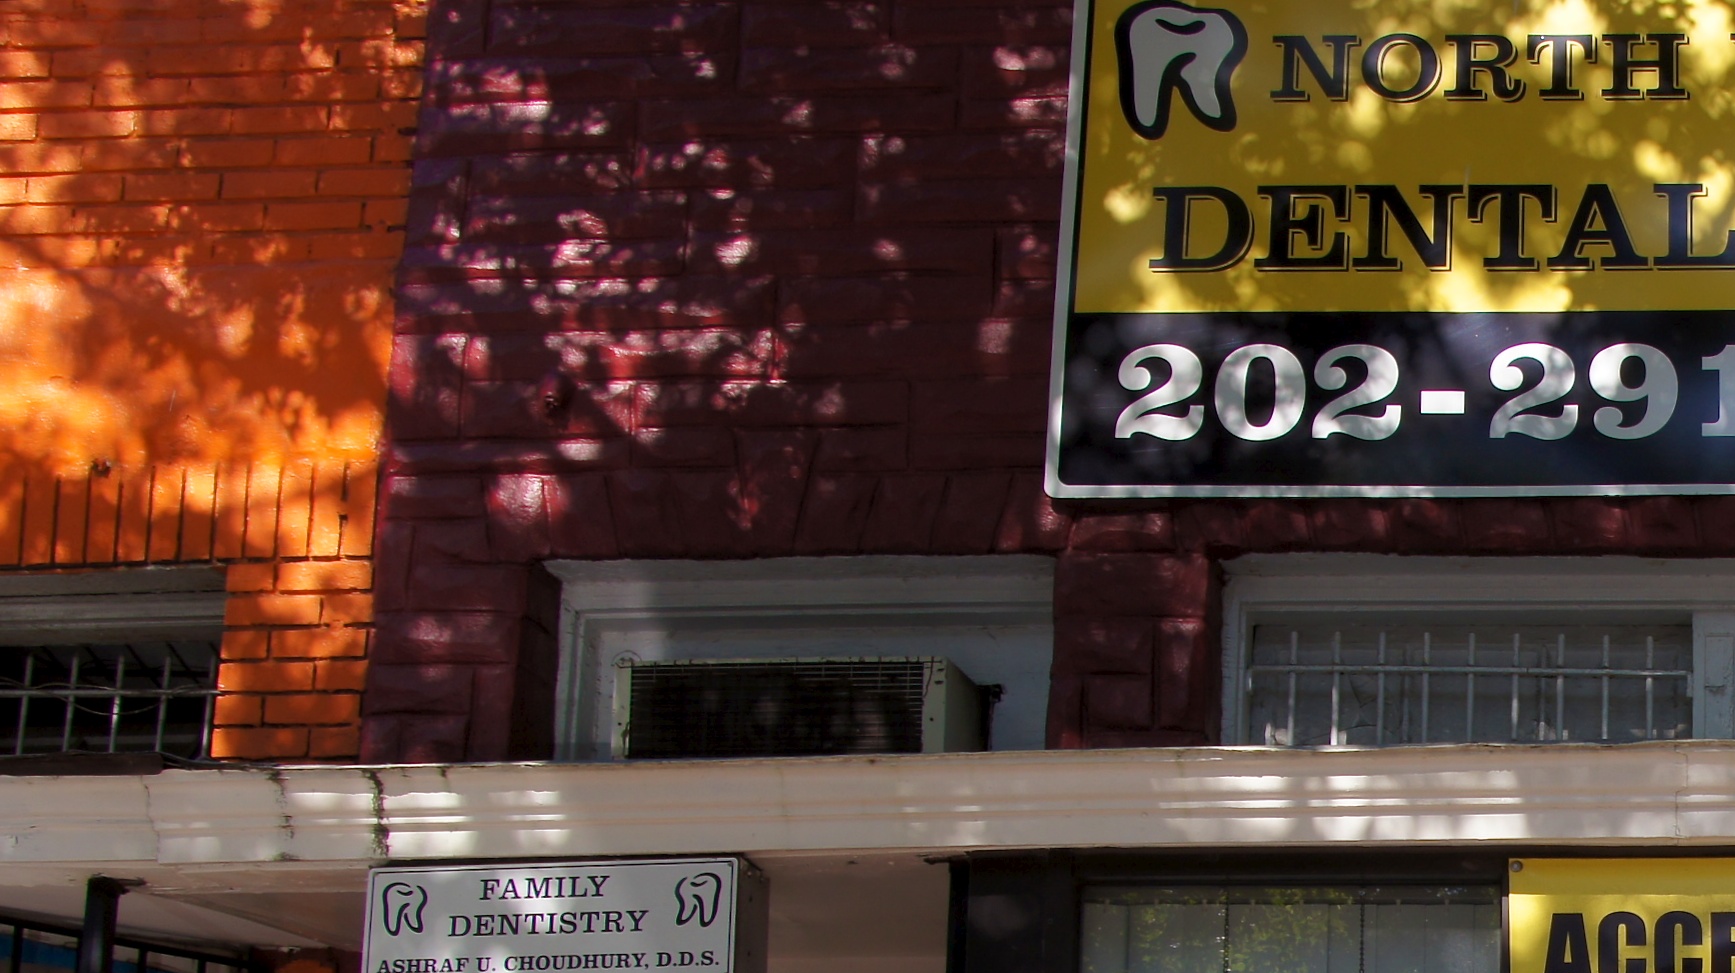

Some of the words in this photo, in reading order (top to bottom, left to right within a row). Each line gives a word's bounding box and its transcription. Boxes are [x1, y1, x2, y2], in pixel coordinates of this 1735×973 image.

[1269, 32, 1690, 104] NORTH
[479, 875, 610, 901] FAMILY
[447, 909, 649, 938] DENTISTRY
[476, 956, 496, 972] U.
[503, 951, 649, 972] CHOUDHURY,
[655, 949, 720, 968] D.D.S.
